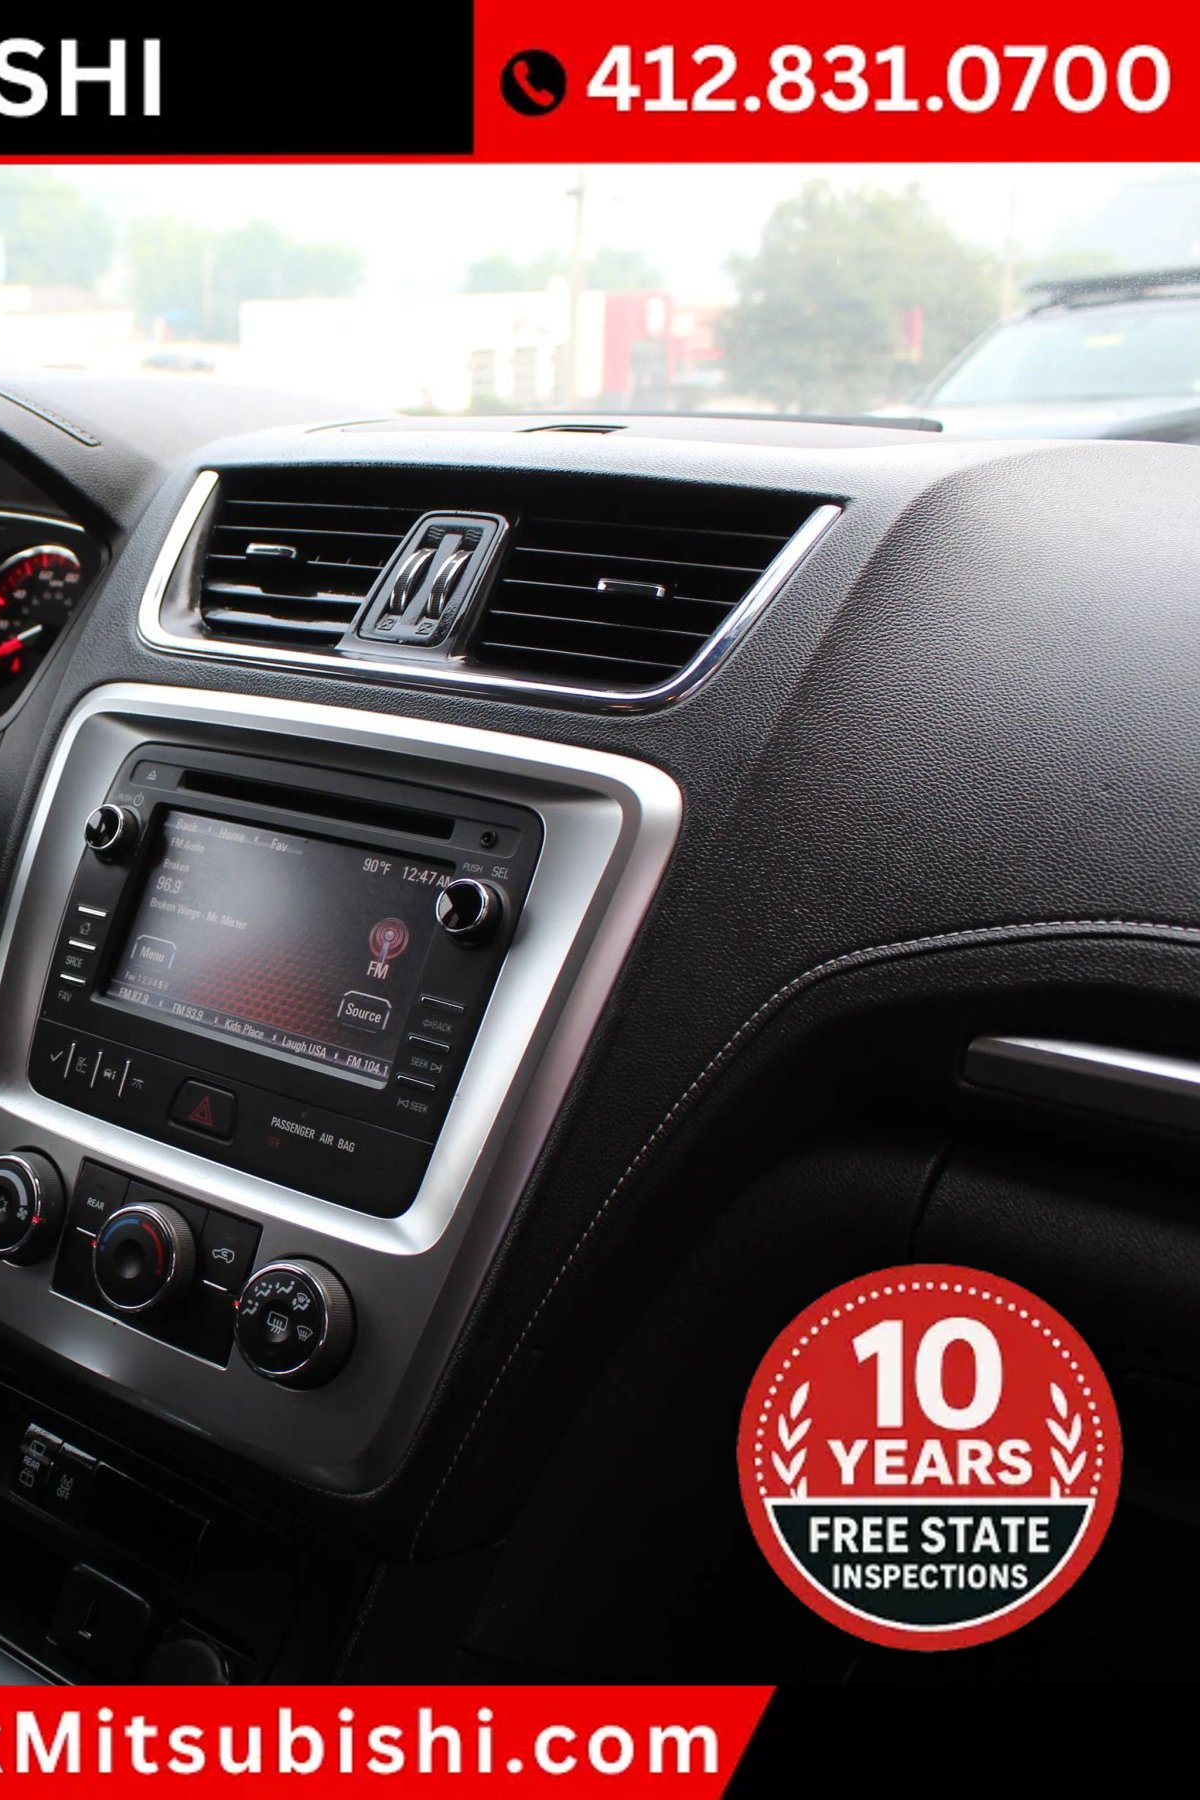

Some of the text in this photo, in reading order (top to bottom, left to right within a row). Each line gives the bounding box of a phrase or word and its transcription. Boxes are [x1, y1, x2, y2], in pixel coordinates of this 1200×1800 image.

[218, 828, 245, 843] Home
[270, 837, 289, 853] Fav
[462, 862, 509, 880] PUSH SEL
[156, 875, 182, 894] 96.9
[65, 955, 85, 968] SRCE
[140, 945, 165, 963] Menu
[366, 960, 389, 980] FM
[57, 990, 72, 1002] FAV
[345, 1002, 382, 1023] Source
[118, 987, 133, 999] FM
[171, 1003, 186, 1015] FM
[224, 1018, 242, 1033] Kids
[242, 1023, 264, 1040] Place
[282, 1035, 307, 1053] Laugh
[308, 1043, 326, 1058] USA
[346, 1054, 362, 1069] FM
[270, 1116, 355, 1153] PASSENGER AIR BAG
[87, 1197, 105, 1211] REAR
[23, 1455, 41, 1472] REAR
